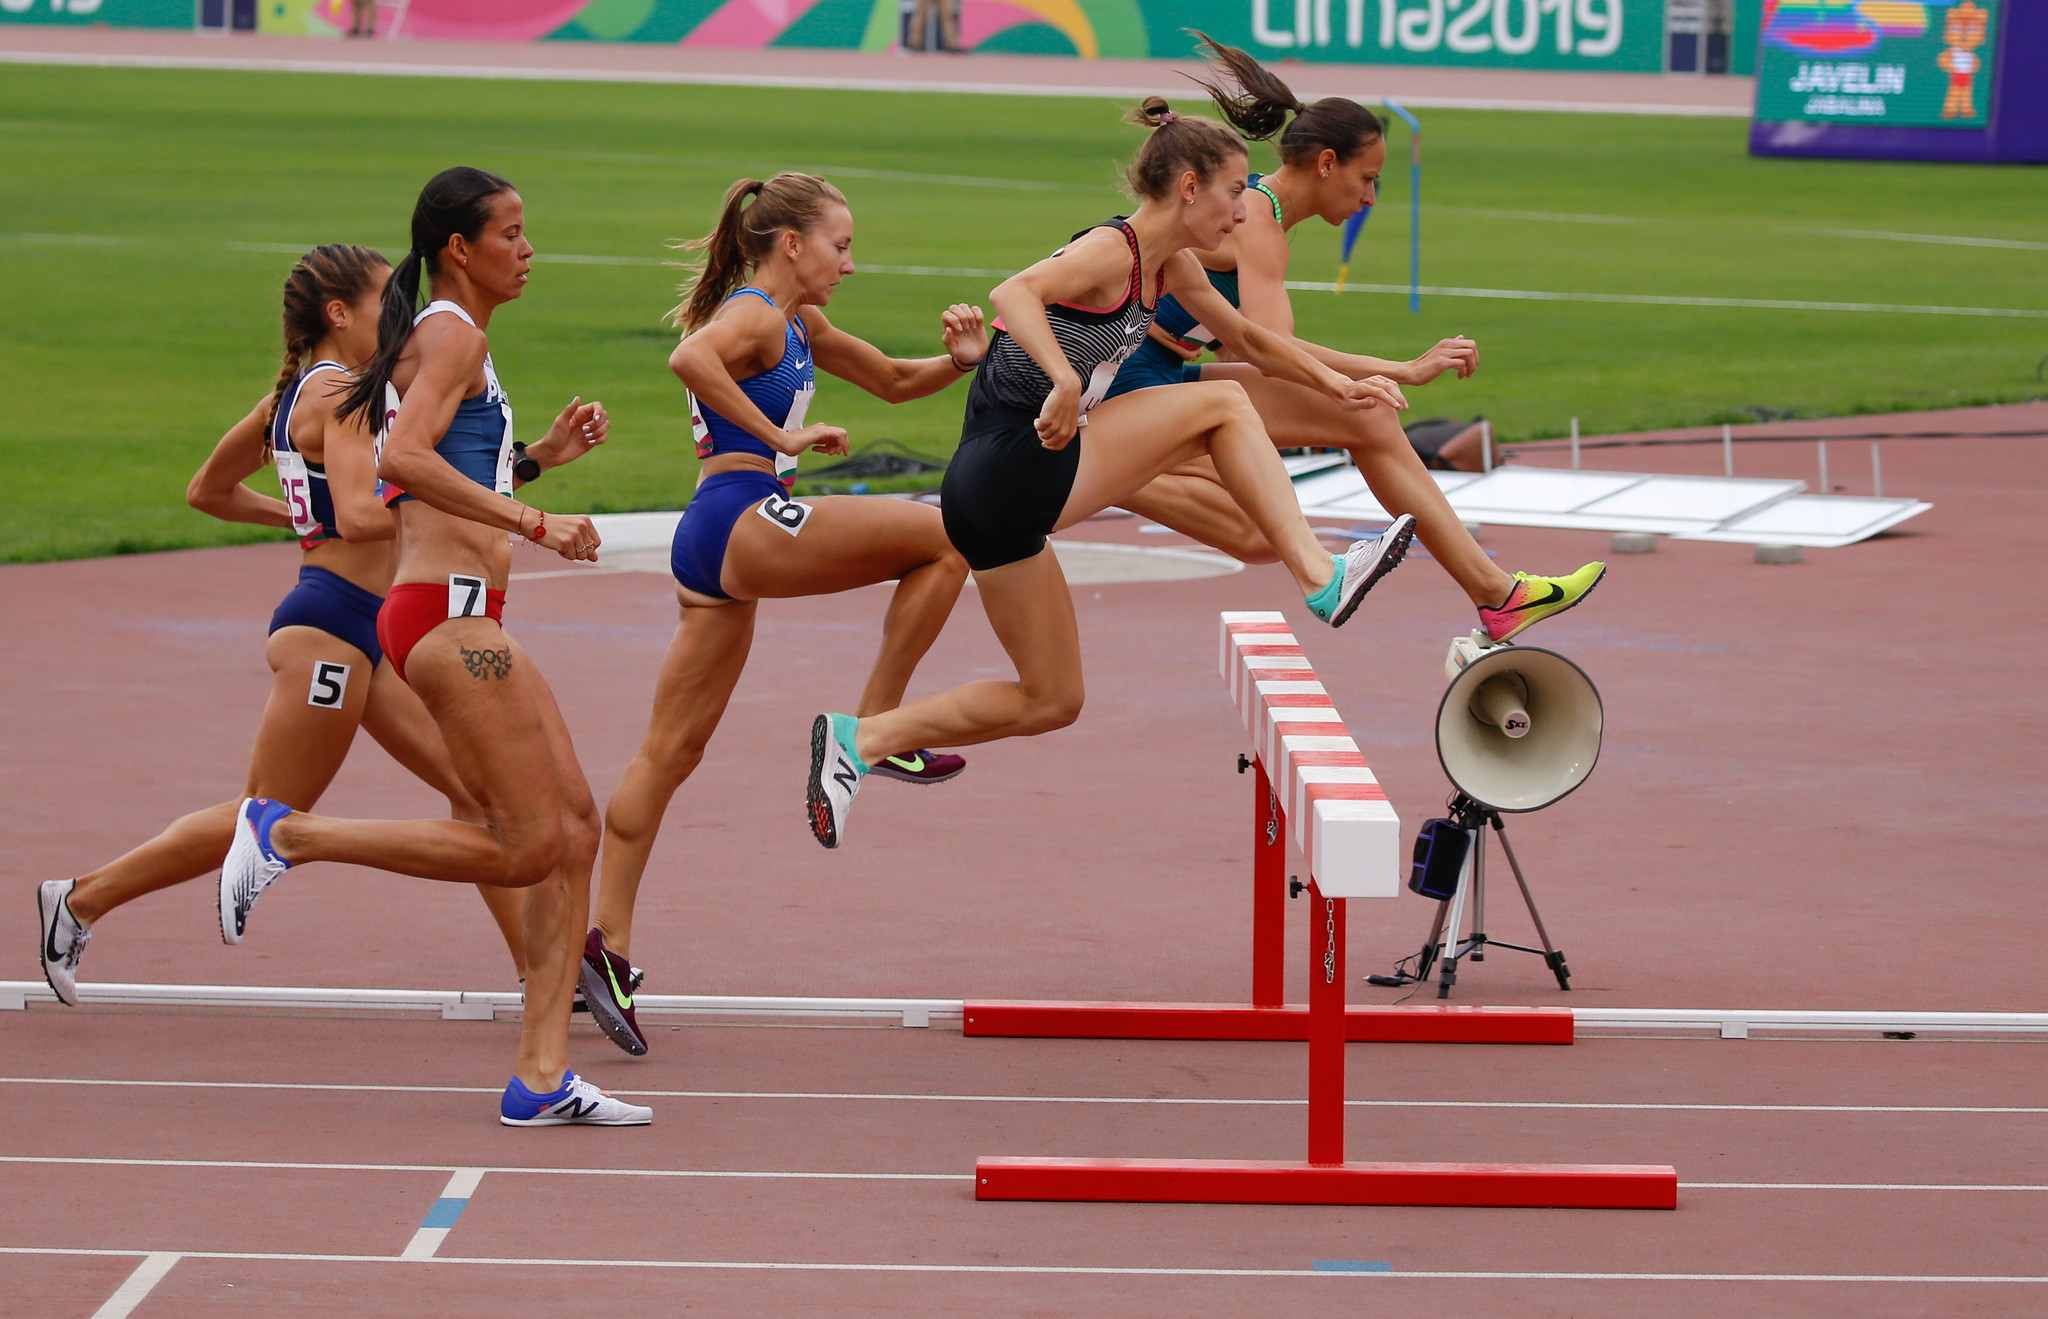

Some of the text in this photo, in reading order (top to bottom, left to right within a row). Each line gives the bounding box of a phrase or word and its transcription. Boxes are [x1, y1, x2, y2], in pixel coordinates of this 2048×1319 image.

[1789, 62, 1905, 94] JAVELIN
[764, 496, 805, 528] 6
[453, 577, 482, 617] 7
[312, 664, 345, 706] 5
